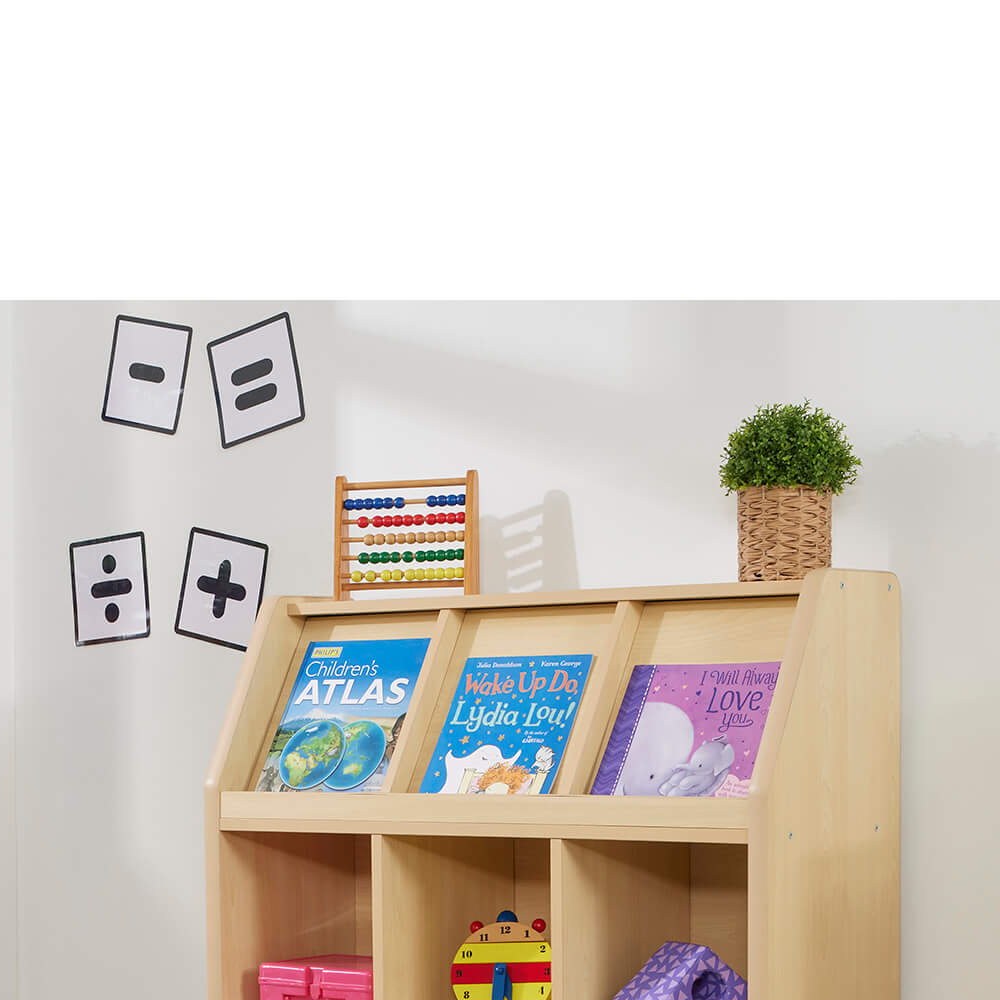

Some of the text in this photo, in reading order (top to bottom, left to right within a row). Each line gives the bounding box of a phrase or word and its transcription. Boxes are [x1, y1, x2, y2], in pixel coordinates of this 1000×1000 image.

[305, 660, 379, 677] Children's
[465, 669, 578, 699] Wake Up Do,
[699, 669, 779, 690] I Will Alway
[294, 678, 409, 705] ATLAS
[449, 700, 576, 732] Lydia Lou!
[480, 930, 529, 941] 11 1
[500, 926, 511, 934] 12
[462, 945, 546, 959] 10 2
[544, 967, 550, 976] 3
[463, 991, 470, 999] 8
